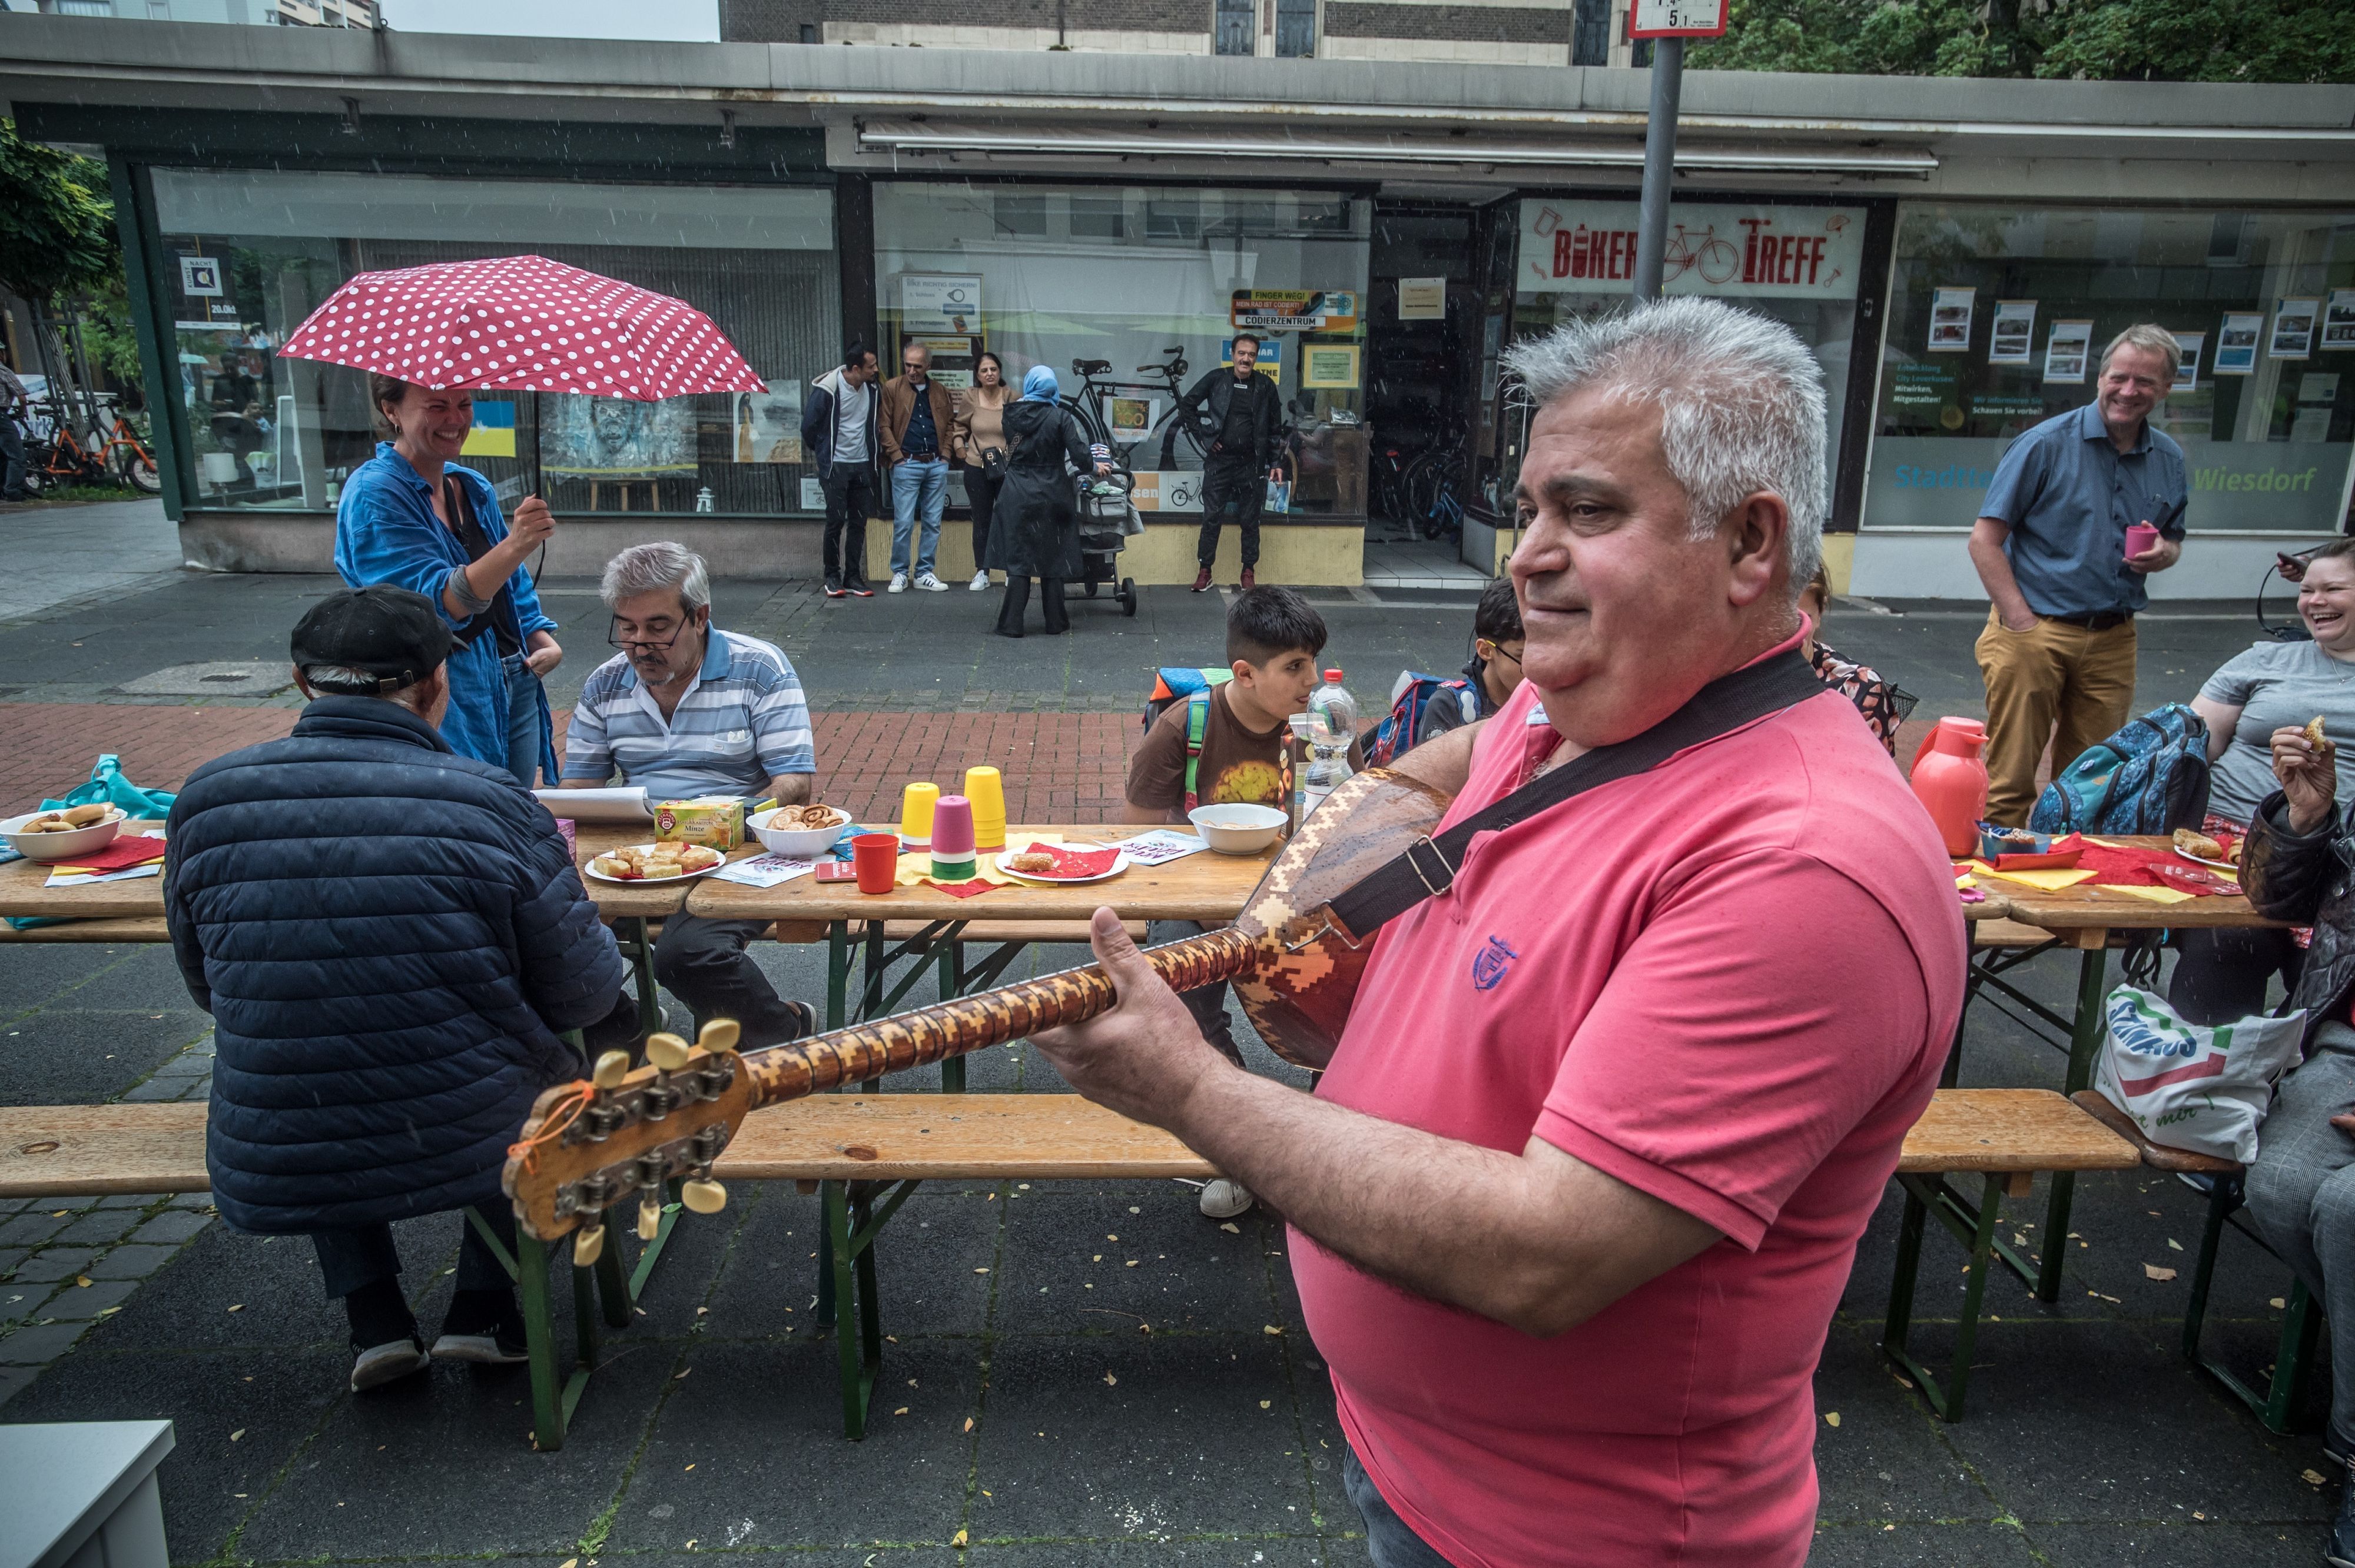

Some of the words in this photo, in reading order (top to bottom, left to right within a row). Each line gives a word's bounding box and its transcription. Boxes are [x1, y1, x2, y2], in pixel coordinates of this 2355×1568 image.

[1739, 218, 1827, 284] TREFF
[184, 267, 193, 288] KUNST
[1245, 316, 1316, 325] CODIERZENTRUM
[1896, 374, 1909, 383] City
[1895, 385, 1932, 394] Mitwirken,
[1893, 395, 1941, 405] Mitgestalten!
[1894, 464, 1994, 489] Stadtte
[1130, 489, 1158, 499] sen
[2156, 1107, 2197, 1127] mir
